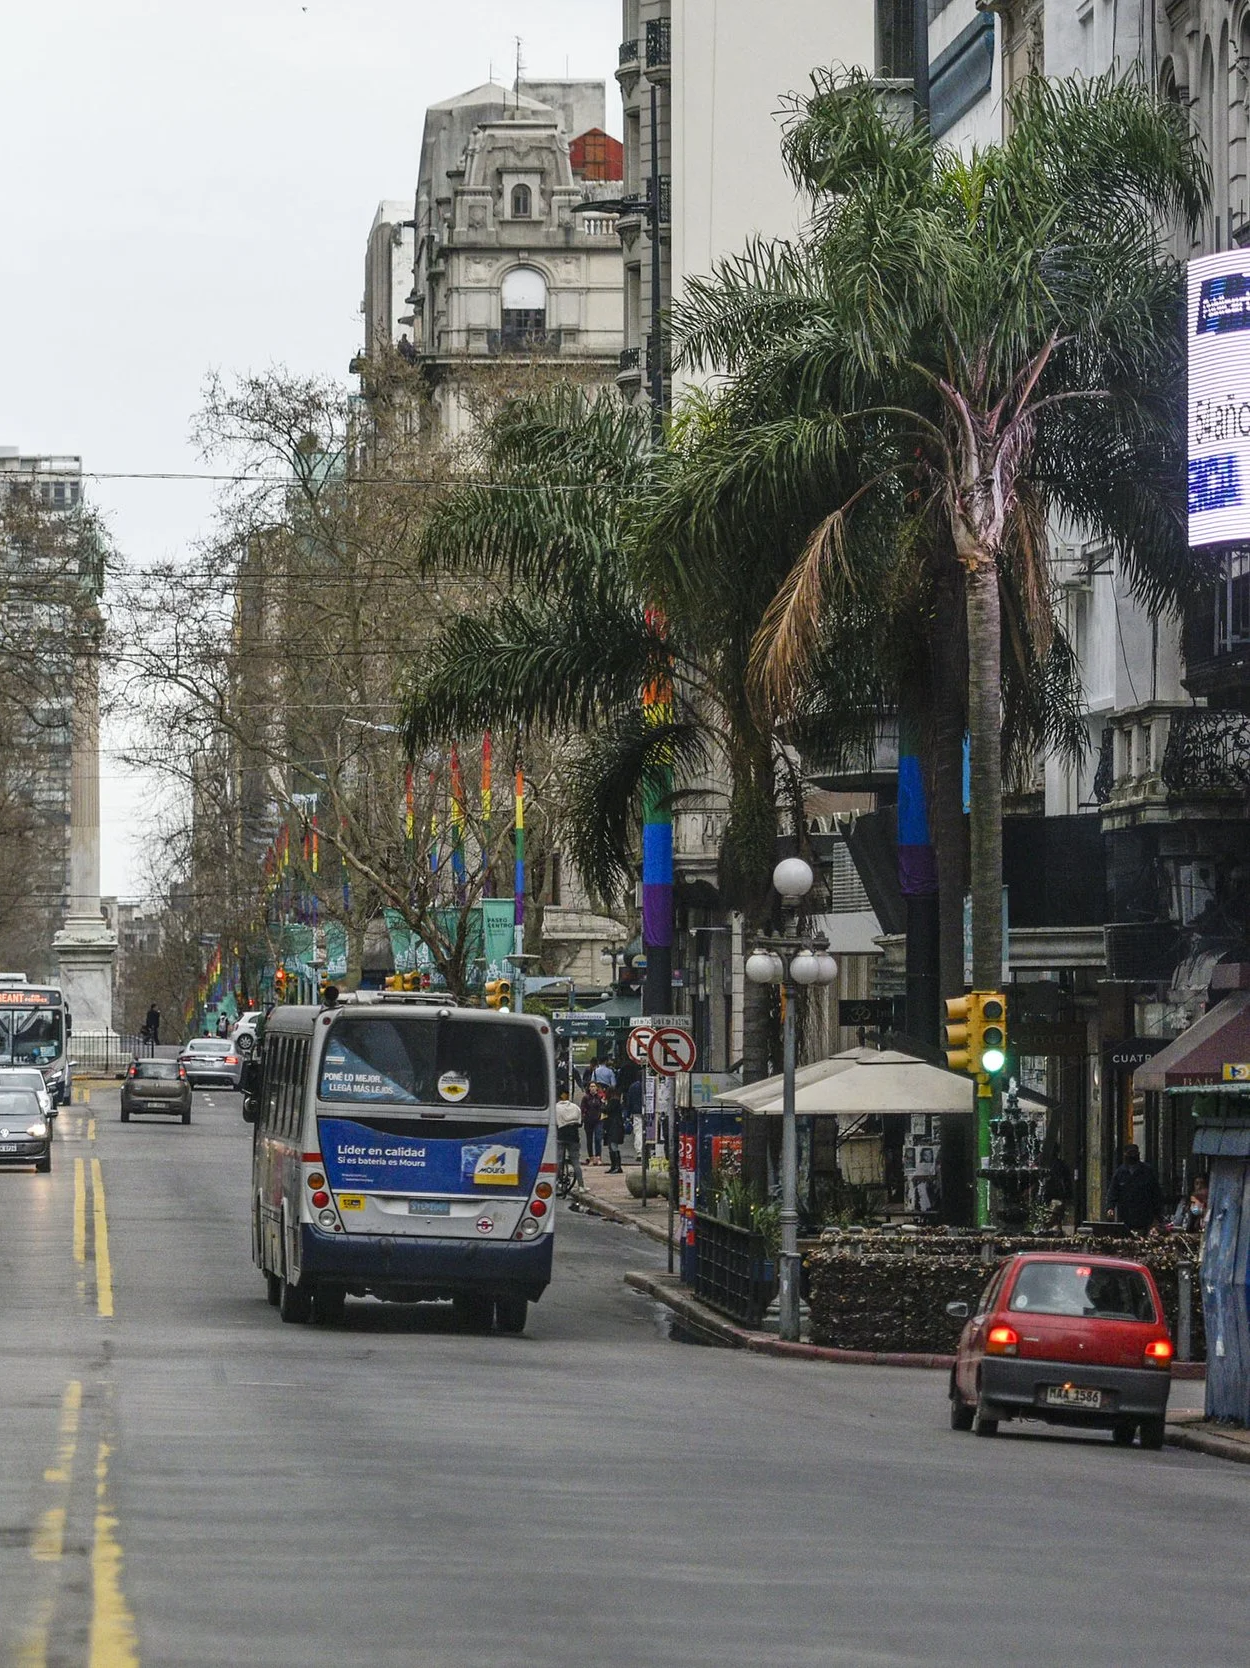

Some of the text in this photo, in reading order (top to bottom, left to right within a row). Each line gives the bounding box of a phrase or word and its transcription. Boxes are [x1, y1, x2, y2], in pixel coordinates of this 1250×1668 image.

[324, 1072, 343, 1081] PONÉ
[344, 1073, 354, 1081] LO
[353, 1083, 370, 1093] MÁS
[337, 1145, 366, 1155] Líder
[384, 1147, 426, 1157] calidad
[399, 1159, 426, 1167] Moura
